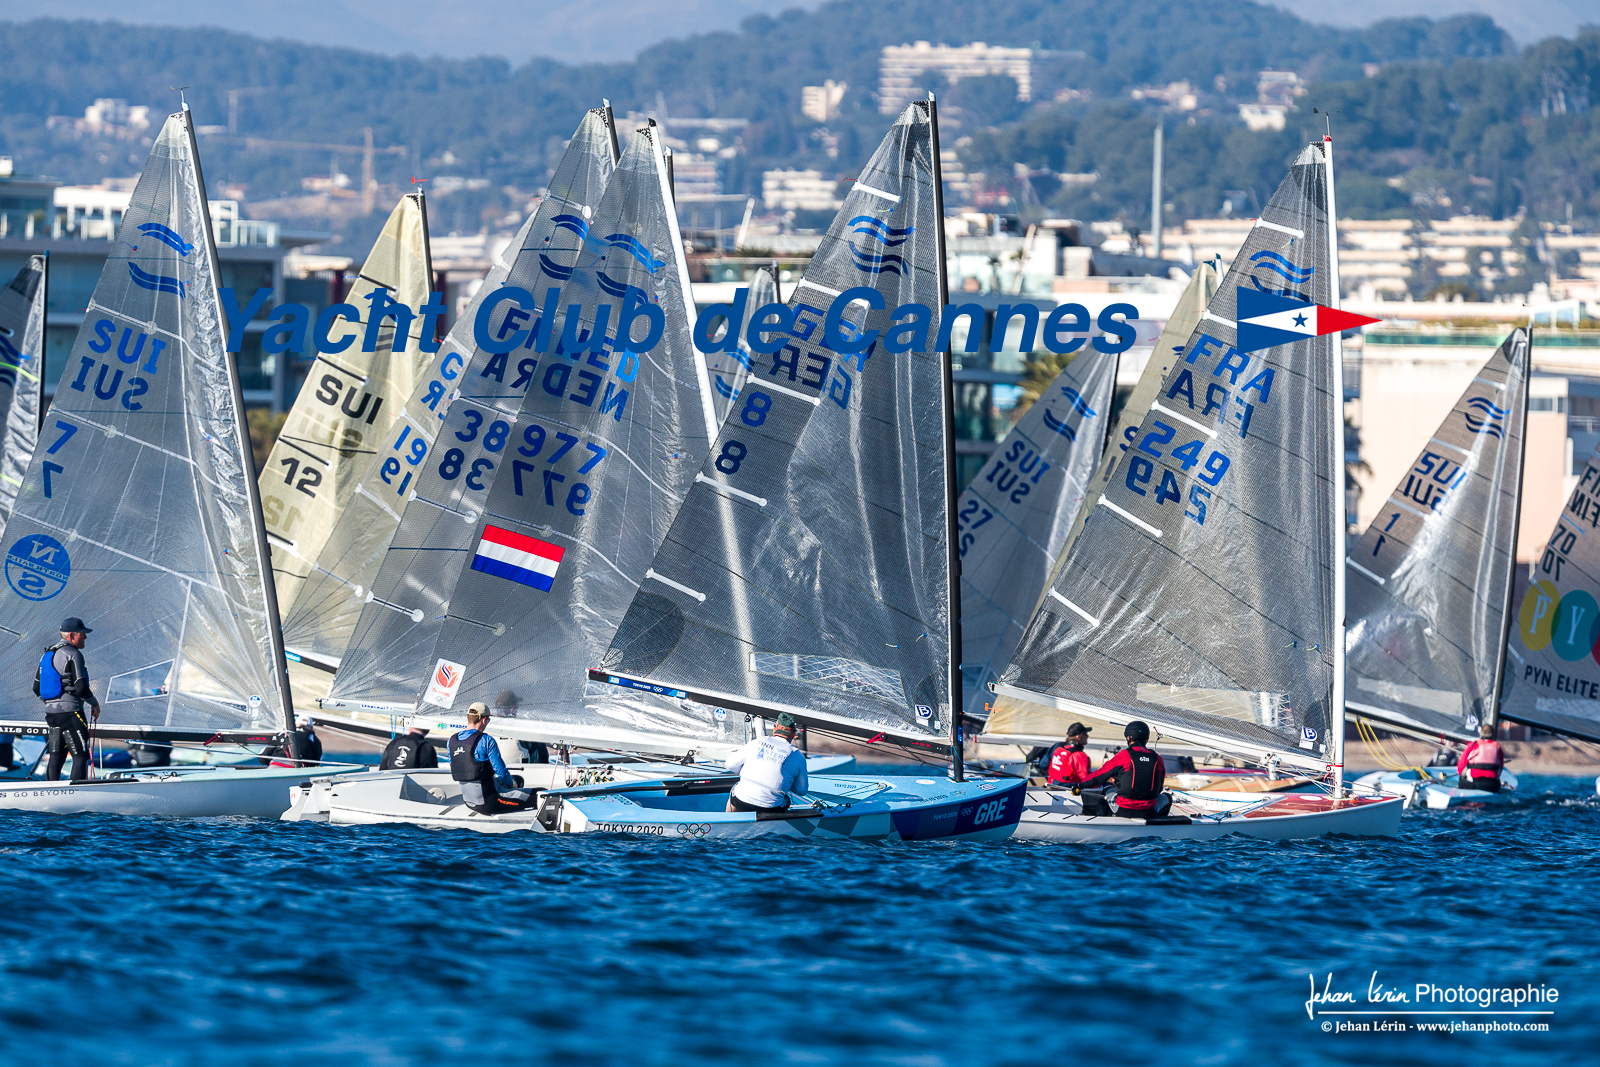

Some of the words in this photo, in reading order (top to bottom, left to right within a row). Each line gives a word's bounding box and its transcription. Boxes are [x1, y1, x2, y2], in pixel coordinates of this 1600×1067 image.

[87, 319, 167, 375] SUI
[1185, 333, 1276, 404] FRA
[316, 374, 384, 426] SUI
[740, 391, 772, 427] 8
[46, 420, 78, 455] 7
[393, 425, 428, 466] 19
[455, 409, 510, 453] 38
[517, 424, 608, 475] 977
[1005, 440, 1050, 485] SUI
[1137, 420, 1231, 487] 249
[1414, 452, 1467, 490] SUI
[280, 457, 323, 499] 12
[1580, 465, 1600, 498] FI
[959, 499, 993, 530] 27
[1384, 512, 1400, 532] 1
[1550, 524, 1577, 555] 70
[1524, 665, 1552, 687] PYN
[1556, 674, 1600, 699] ELITE
[636, 825, 664, 836] 2020
[974, 797, 1009, 826] GRE
